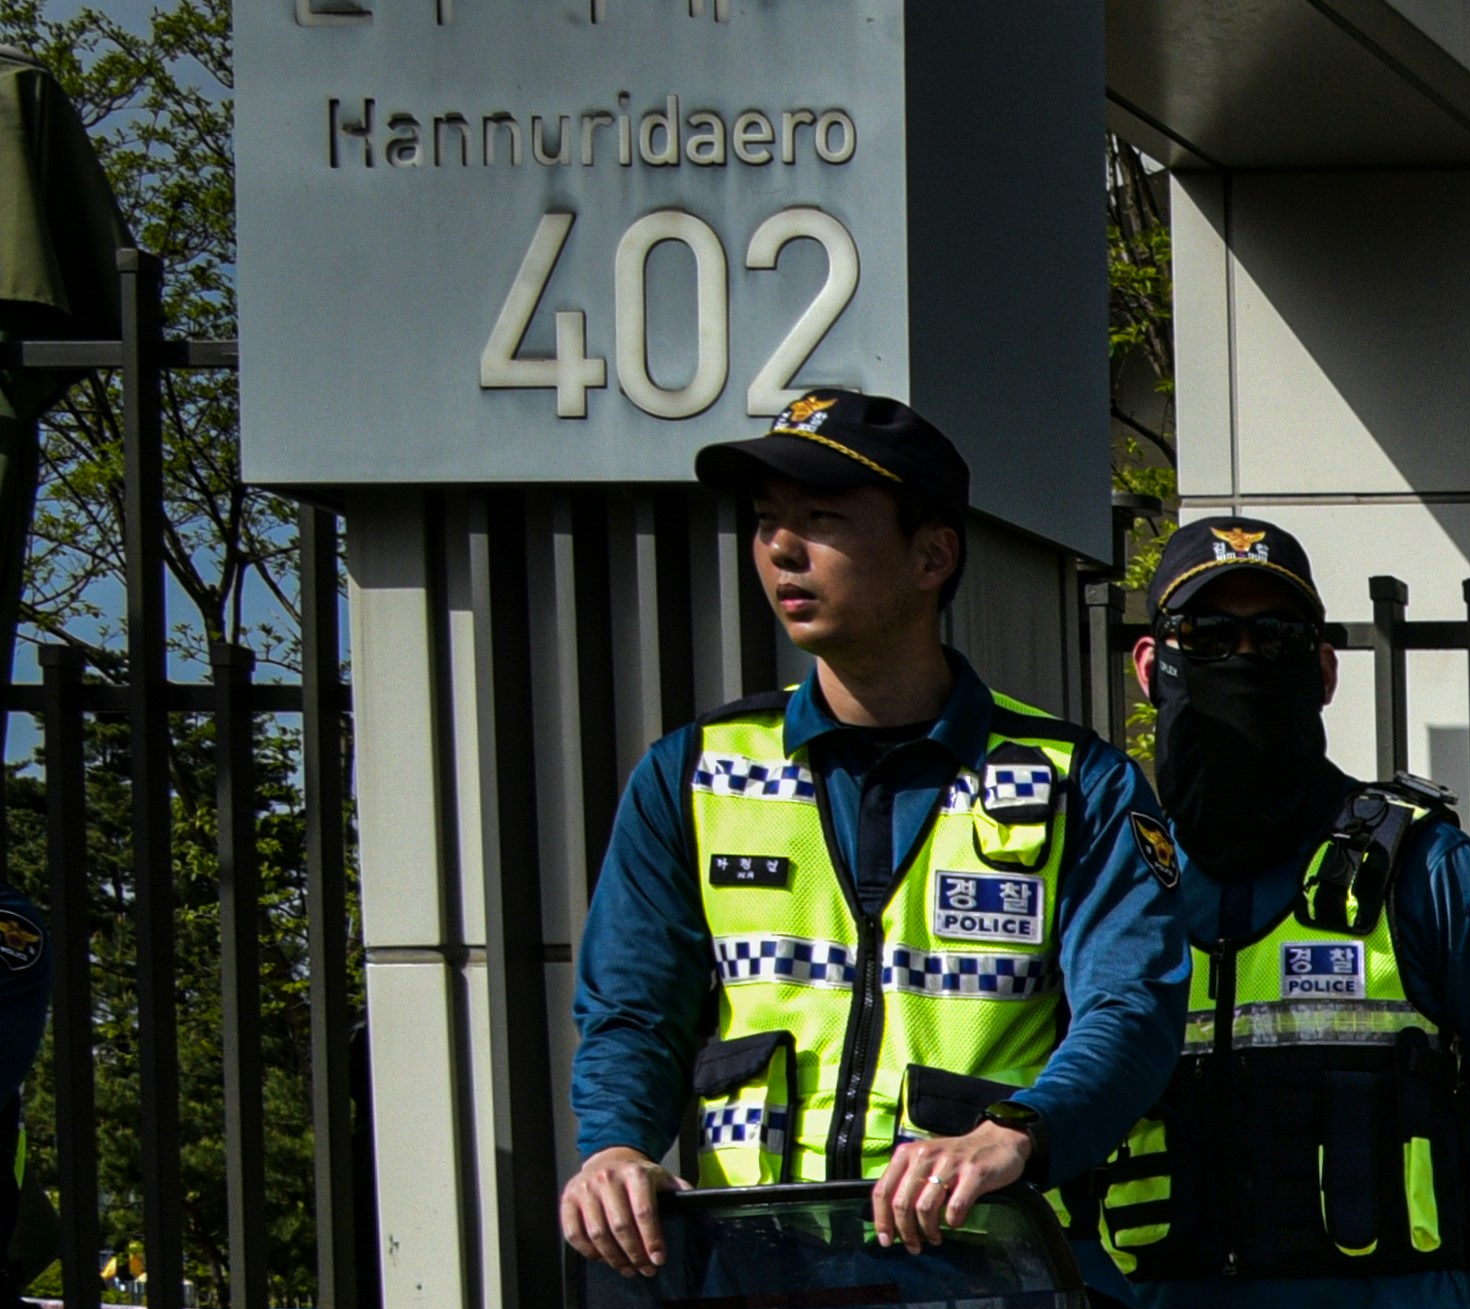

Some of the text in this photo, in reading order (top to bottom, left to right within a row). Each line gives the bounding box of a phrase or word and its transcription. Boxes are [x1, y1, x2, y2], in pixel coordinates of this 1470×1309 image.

[329, 91, 856, 168] Hannuridaero
[480, 206, 860, 421] 402
[945, 878, 1032, 912] 경찰
[944, 915, 1031, 936] POLICE
[1289, 946, 1354, 974] 경찰
[1288, 979, 1356, 994] POLICE
